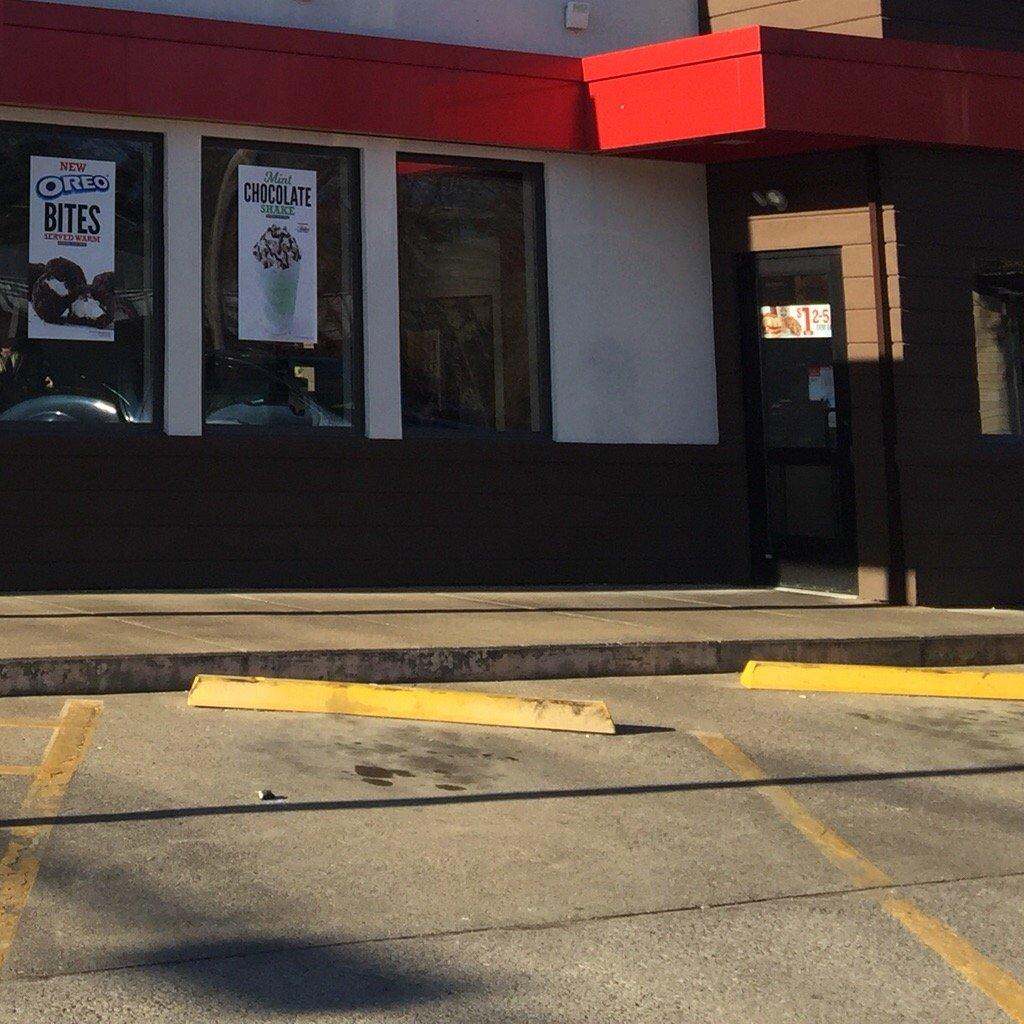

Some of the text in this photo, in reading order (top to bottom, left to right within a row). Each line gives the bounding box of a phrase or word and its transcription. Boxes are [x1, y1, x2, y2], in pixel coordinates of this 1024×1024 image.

[59, 161, 87, 173] NEW
[36, 174, 110, 200] OREO
[264, 171, 293, 185] Mint
[243, 182, 312, 207] CHOCOLATE
[44, 202, 101, 235] BITES
[260, 204, 296, 216] SHAKE
